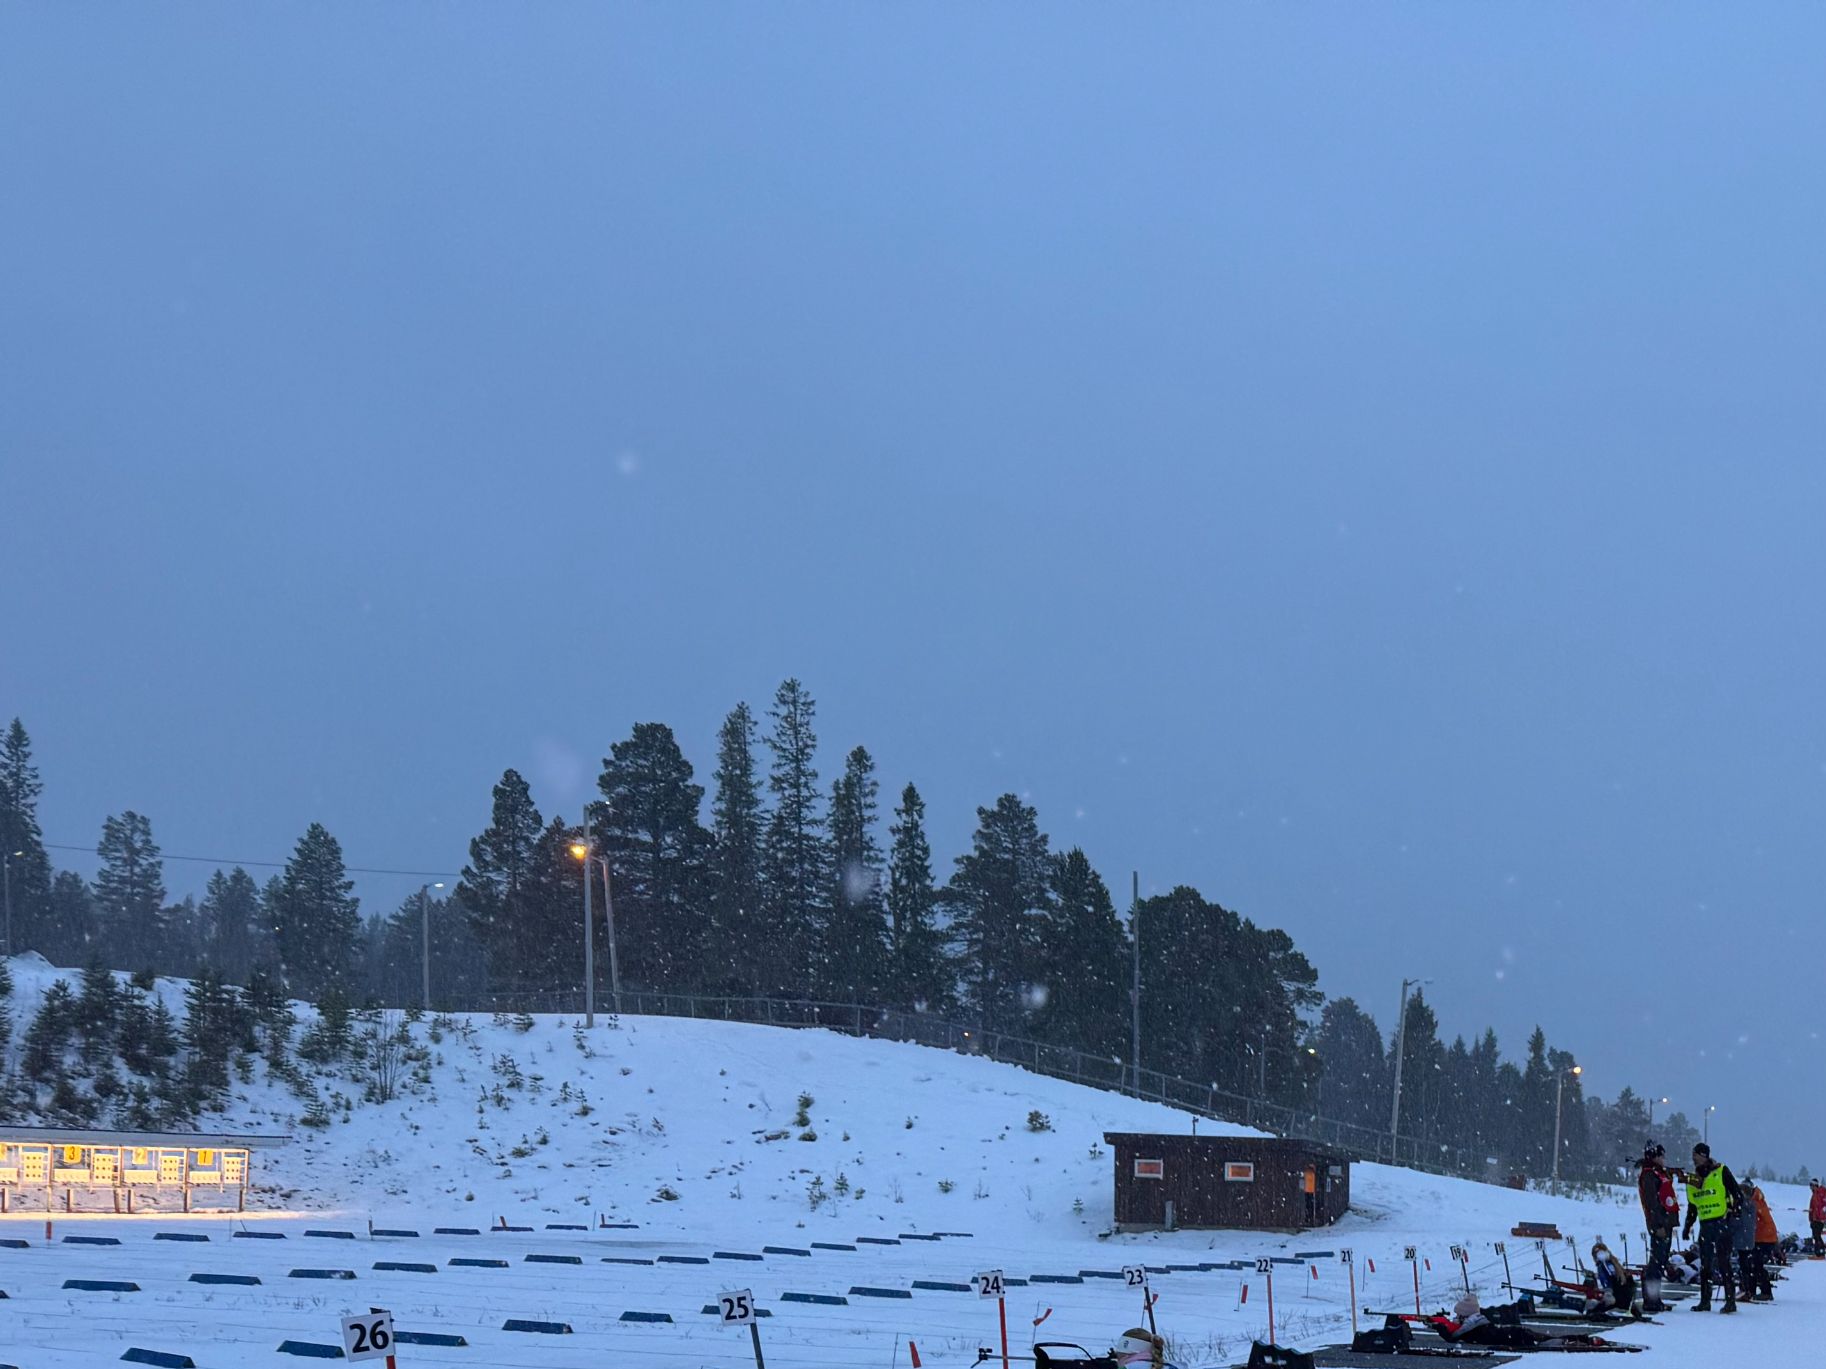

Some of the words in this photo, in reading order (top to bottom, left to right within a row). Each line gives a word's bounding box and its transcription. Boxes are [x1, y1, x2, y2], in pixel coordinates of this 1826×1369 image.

[68, 1146, 76, 1160] 3
[201, 1150, 208, 1164] 1
[1341, 1250, 1351, 1263] 21
[1405, 1248, 1415, 1259] 20
[1256, 1259, 1269, 1273] 22
[1127, 1268, 1145, 1286] 23
[981, 1275, 1000, 1295] 24
[722, 1296, 749, 1321] 25
[349, 1319, 390, 1354] 26
